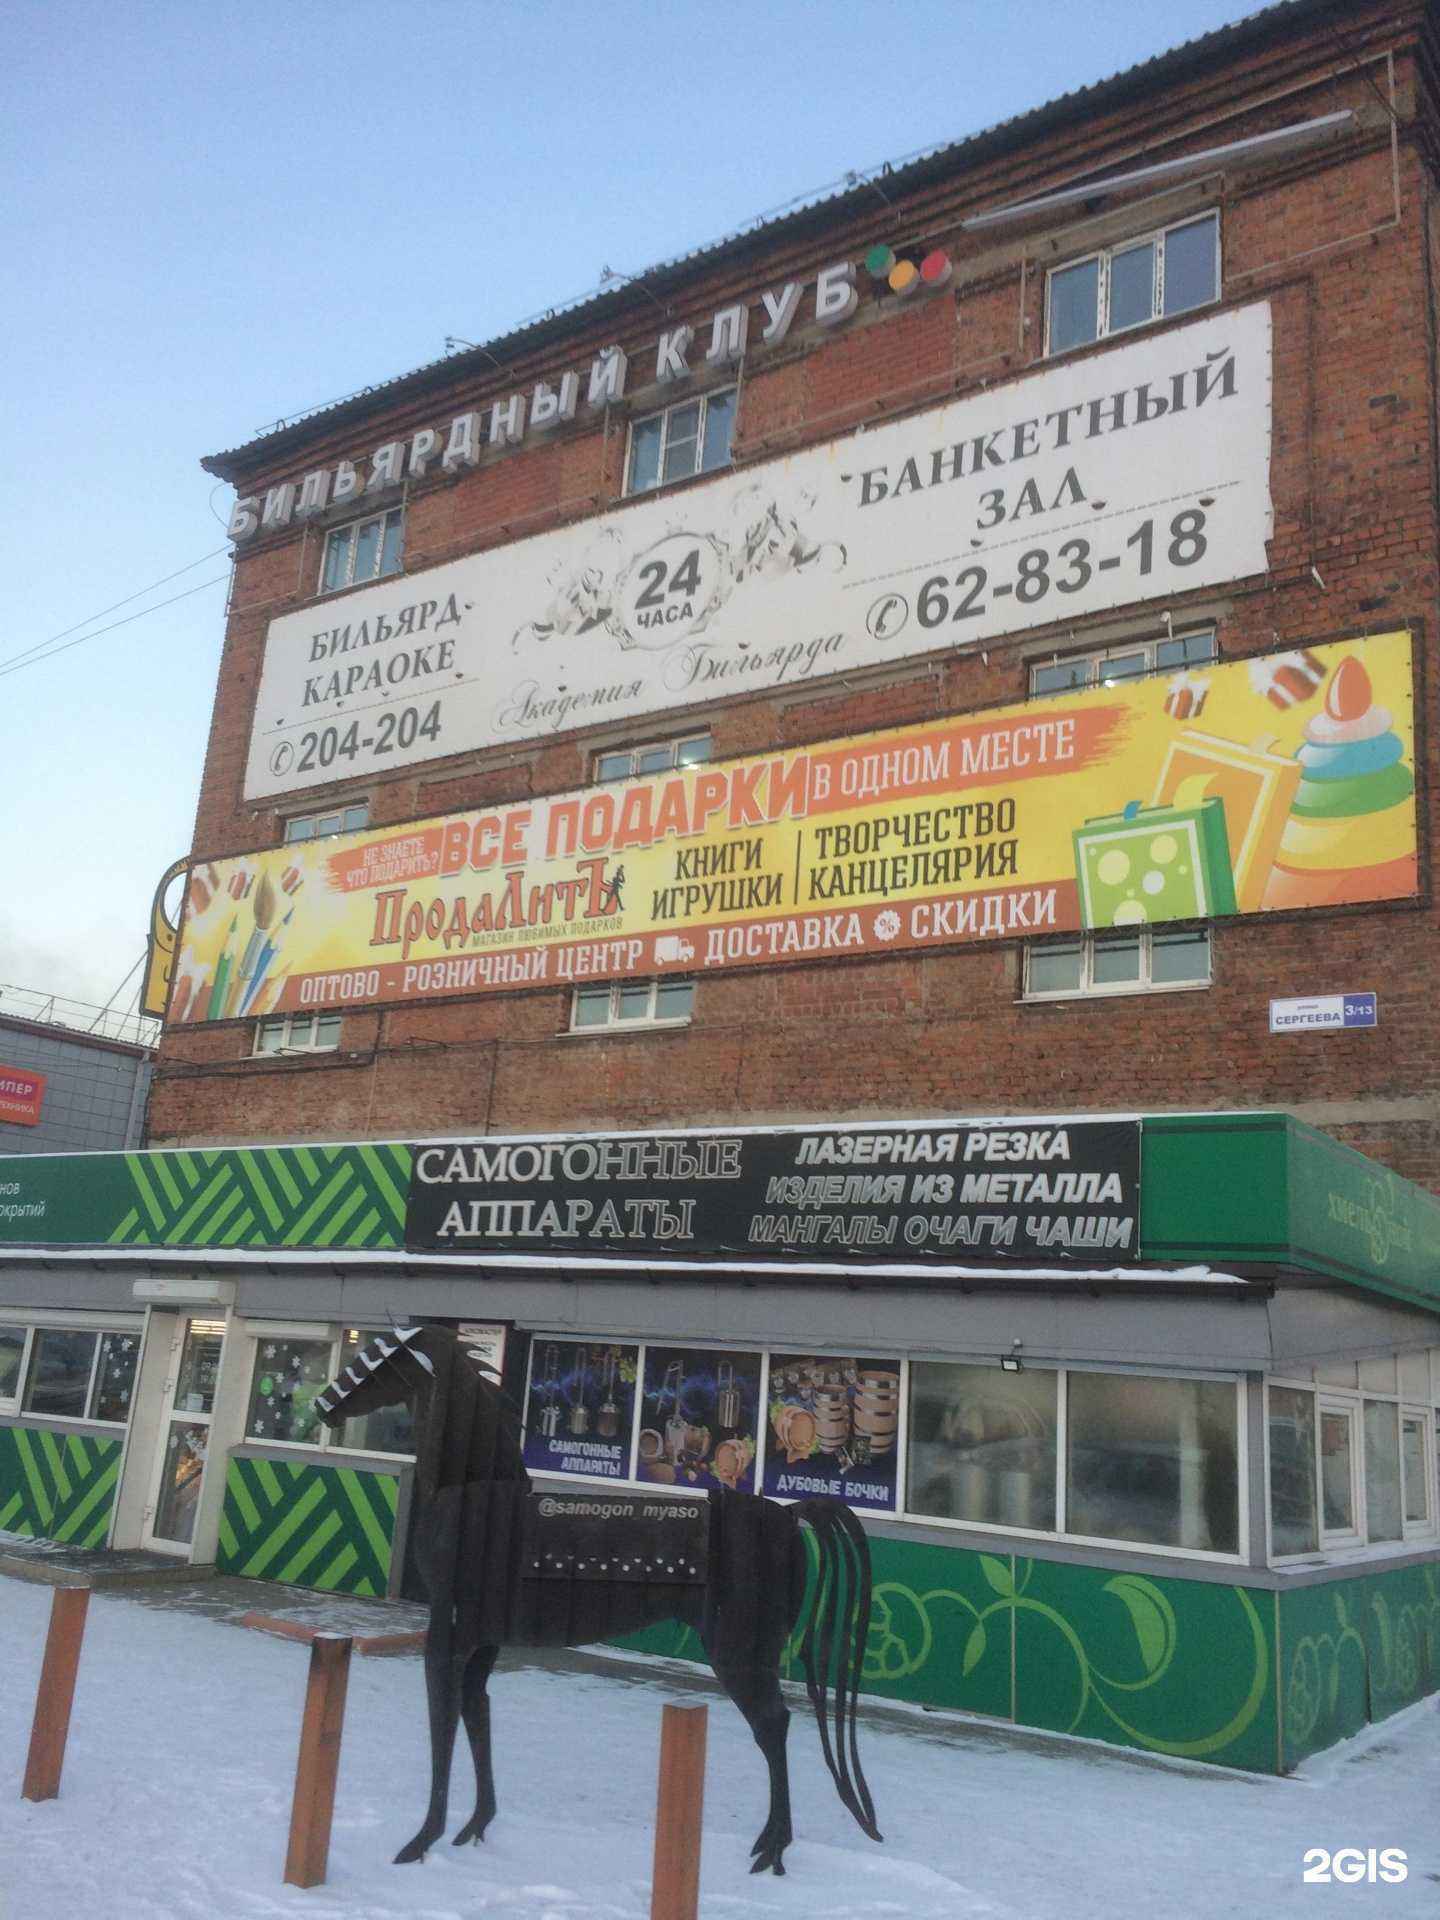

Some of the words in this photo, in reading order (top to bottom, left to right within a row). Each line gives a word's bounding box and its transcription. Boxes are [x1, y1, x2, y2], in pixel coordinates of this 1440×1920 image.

[227, 343, 628, 542] БИЛЬЯРДНЫЙ
[656, 261, 858, 383] КЛУБ
[858, 346, 1238, 507] БАНКЕТНЫЙ
[977, 466, 1087, 529] ЗАЛ
[635, 558, 701, 609] 24
[916, 509, 1208, 630] 62-83-18
[309, 593, 462, 661] БИЛЬЯРД
[636, 603, 693, 631] ЧАСА
[302, 640, 455, 706] КАРАОКЕ
[490, 679, 643, 733] Академия
[663, 632, 844, 692] Бильярда
[296, 702, 441, 772] 204-204
[441, 810, 532, 877] ВСЕ
[546, 753, 811, 857] ПОДАРКИ
[814, 763, 830, 800] В
[841, 742, 949, 797] ОДНОМ
[961, 719, 1075, 776] МЕСТЕ
[363, 847, 379, 866] НЕ
[383, 837, 424, 861] ЗНАЕТЕ
[815, 798, 1017, 860] ТВОРЧЕСТВО
[346, 868, 368, 888] ЧТО
[674, 838, 763, 880] КНИГИ
[809, 839, 1018, 900] КАНЦЕЛЯРИЯ
[650, 872, 783, 921] ИГРУШКИ
[299, 970, 380, 1005] ОПТОВО
[402, 944, 547, 993] РОЗНИЧНЫЙ
[557, 938, 643, 982] ЦЕНТР
[704, 912, 864, 966] ДОСТАВКА
[911, 889, 1057, 939] СКИДКИ
[570, 917, 624, 936] ПОДАРКОВ
[1275, 1012, 1341, 1025] СЕРГЕЕВА
[416, 1138, 743, 1185] САМОГОННЫЕ
[796, 1132, 959, 1165] ЛАЗЕРНАЯ
[963, 1130, 1071, 1162] РЕЗКА
[764, 1175, 906, 1209] ИЗДЕЛИЯ
[910, 1174, 956, 1203] ИЗ
[960, 1173, 1123, 1203] МЕТАЛЛА
[437, 1198, 697, 1240] АППАРАТЫ
[749, 1215, 900, 1244] МАНГАЛЫ
[904, 1215, 1018, 1245] ОЧАГИ
[1026, 1217, 1134, 1248] ЧАШИ
[549, 1439, 623, 1459] САМОГОННЫЕ
[561, 1457, 622, 1475] АППАРАТЫ
[776, 1474, 841, 1495] ДУБОВЫЕ
[845, 1480, 889, 1501] БОЧКИ
